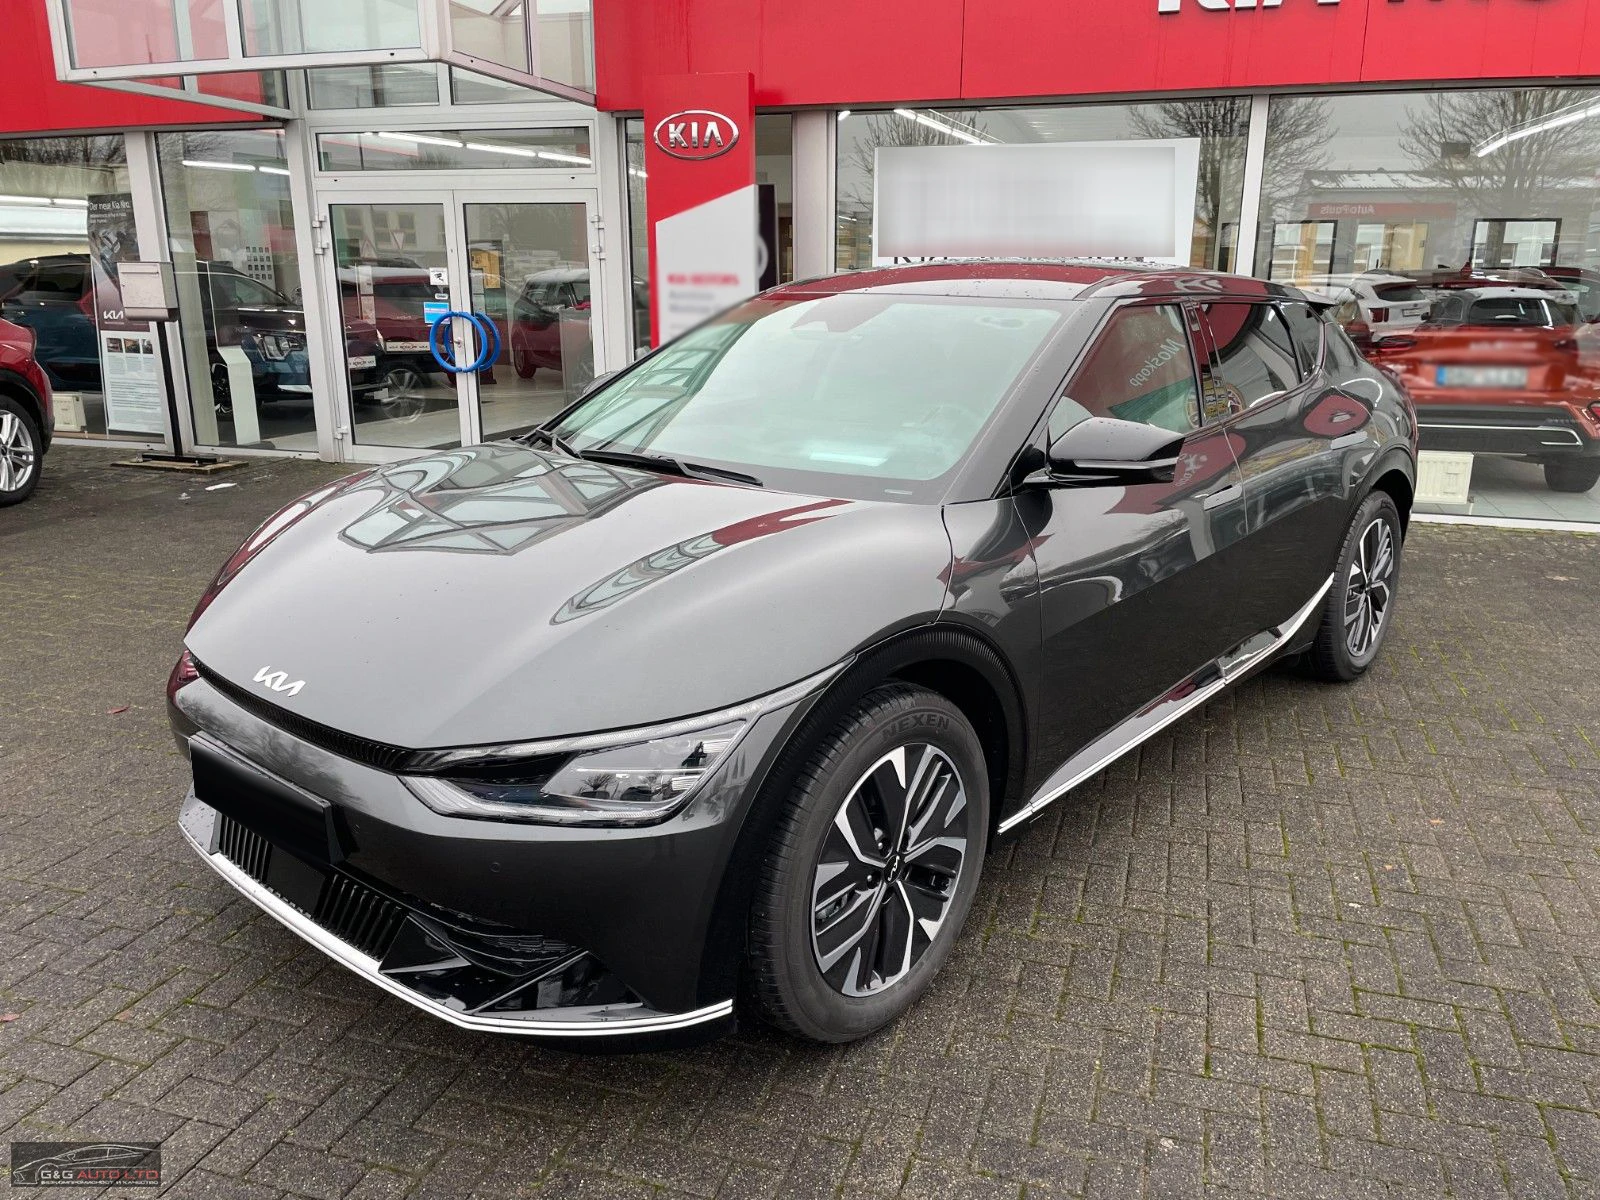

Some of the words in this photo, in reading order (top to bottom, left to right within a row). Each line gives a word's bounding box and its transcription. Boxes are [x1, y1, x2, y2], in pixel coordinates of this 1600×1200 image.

[668, 121, 723, 148] KIA
[253, 665, 306, 697] KIA
[882, 713, 950, 738] NEXEN
